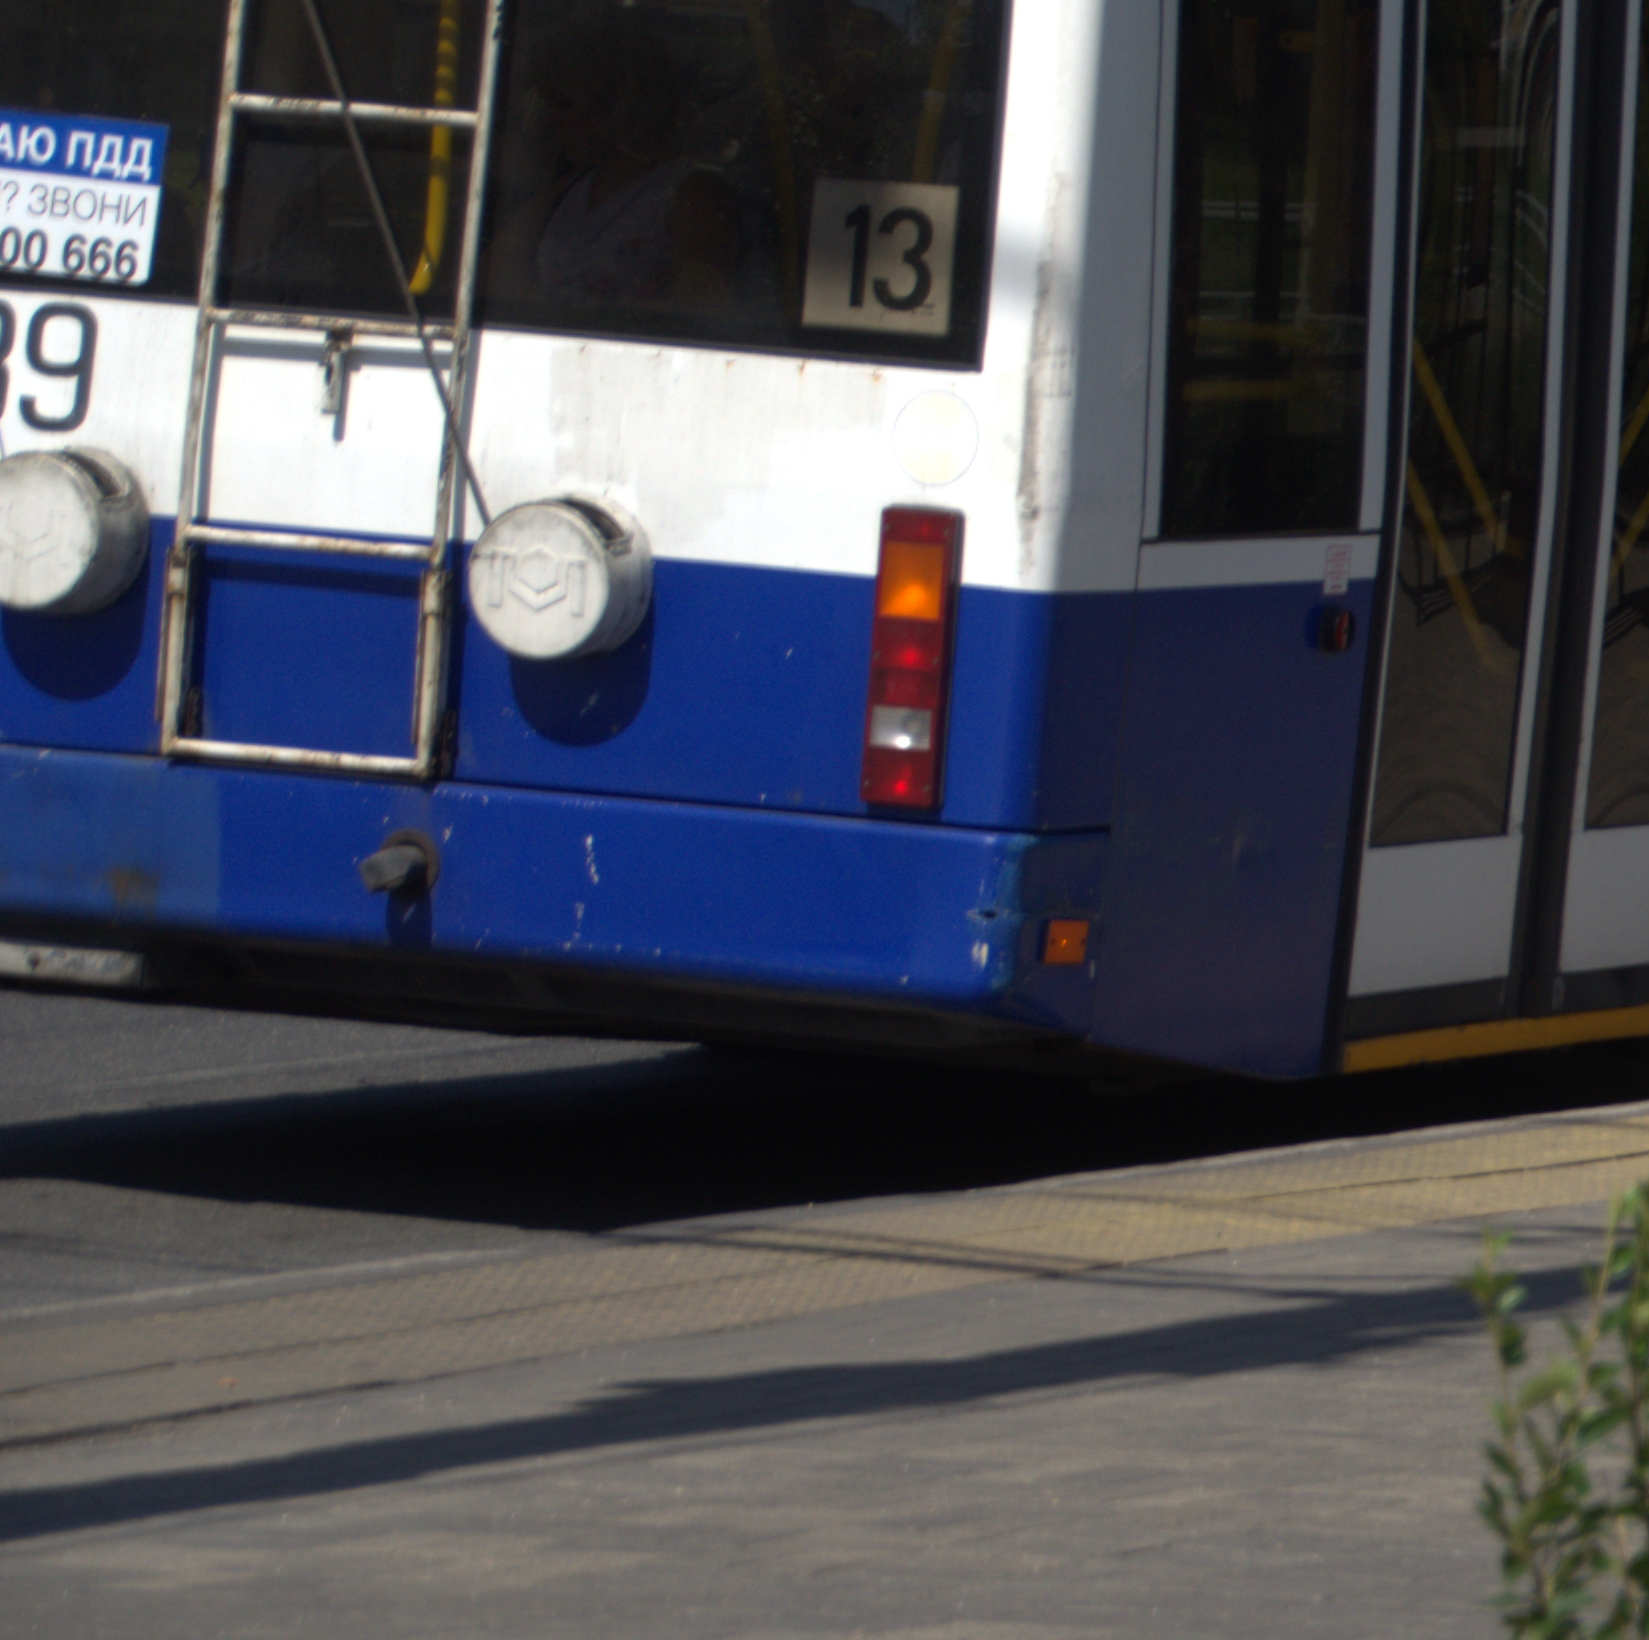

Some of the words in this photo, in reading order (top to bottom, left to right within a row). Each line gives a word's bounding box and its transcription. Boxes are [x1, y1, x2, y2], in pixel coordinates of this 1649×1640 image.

[65, 130, 153, 184] ПДД
[28, 183, 149, 229] ЗВОНИ
[62, 233, 139, 282] 666
[844, 204, 934, 312] 13
[0, 297, 99, 433] 9
